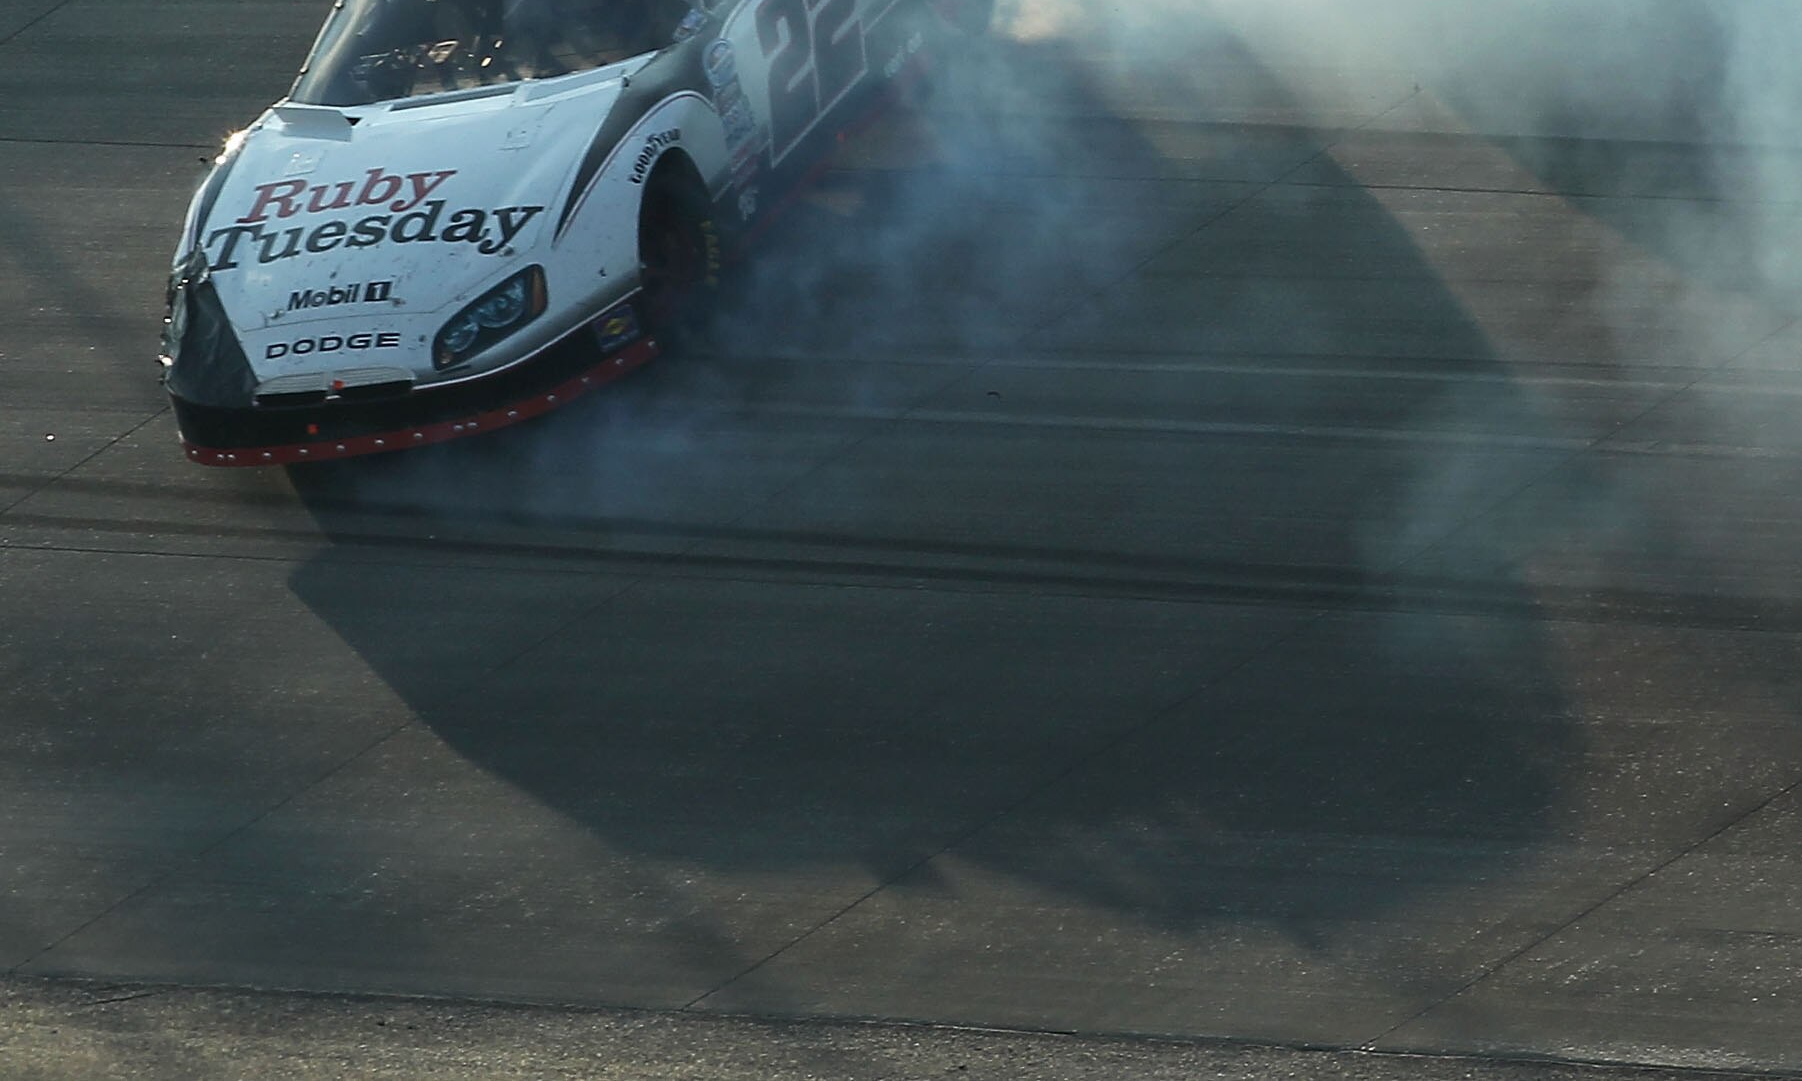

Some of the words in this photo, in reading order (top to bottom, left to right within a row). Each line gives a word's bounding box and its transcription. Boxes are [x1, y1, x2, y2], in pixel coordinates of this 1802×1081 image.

[235, 167, 457, 225] Ruby
[205, 199, 545, 272] Tuesday
[287, 283, 360, 312] Mobil
[264, 332, 400, 360] DODGE
